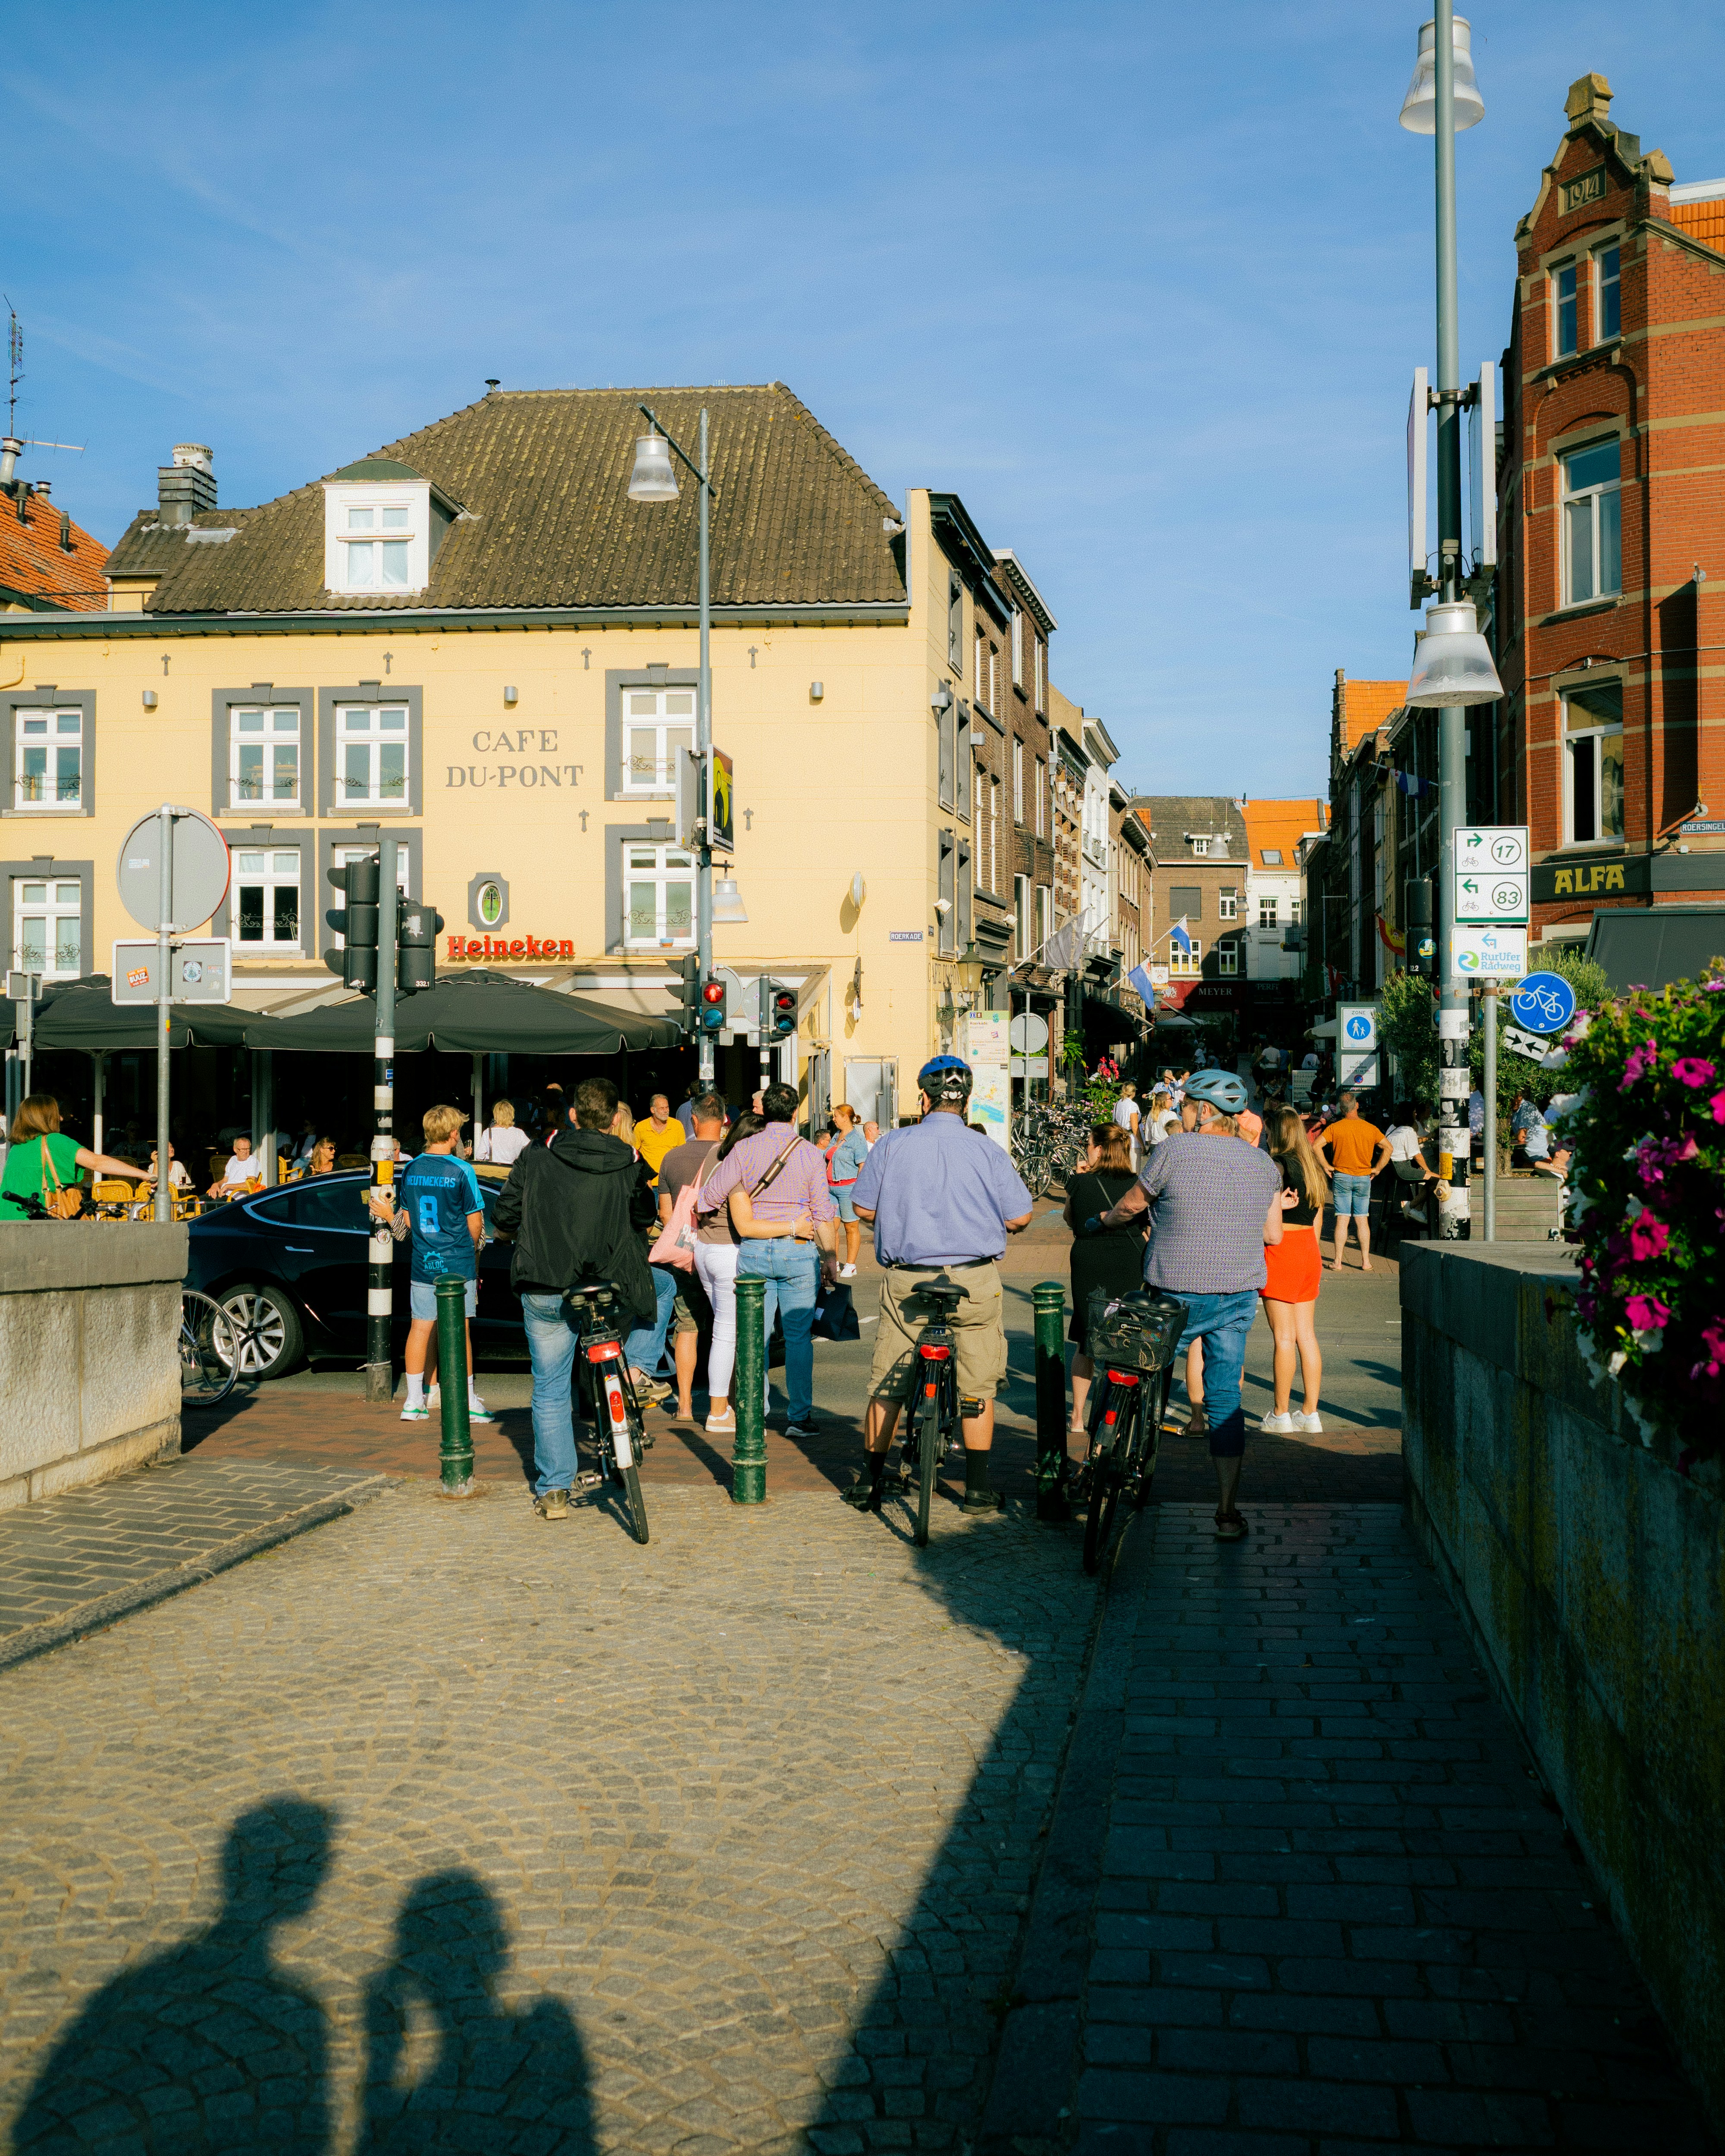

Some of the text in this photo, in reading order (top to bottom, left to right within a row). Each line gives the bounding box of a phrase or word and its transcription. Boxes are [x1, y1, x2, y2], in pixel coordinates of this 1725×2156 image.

[1569, 173, 1600, 207] 1914
[472, 729, 558, 752] CAFE
[445, 765, 584, 788] DU-PONT
[1682, 822, 1725, 832] ROERSINGEL
[1496, 845, 1515, 858] 17
[1555, 864, 1625, 894] ALFA
[1496, 891, 1518, 904] 83
[447, 934, 575, 957] Heineken
[1481, 952, 1521, 961] RurUfer
[1481, 961, 1521, 972] Radweg
[1198, 987, 1233, 996] MEYER
[407, 1175, 456, 1188] HEUTMEKERS
[419, 1195, 441, 1233] 8
[424, 1260, 445, 1270] ABLOC
